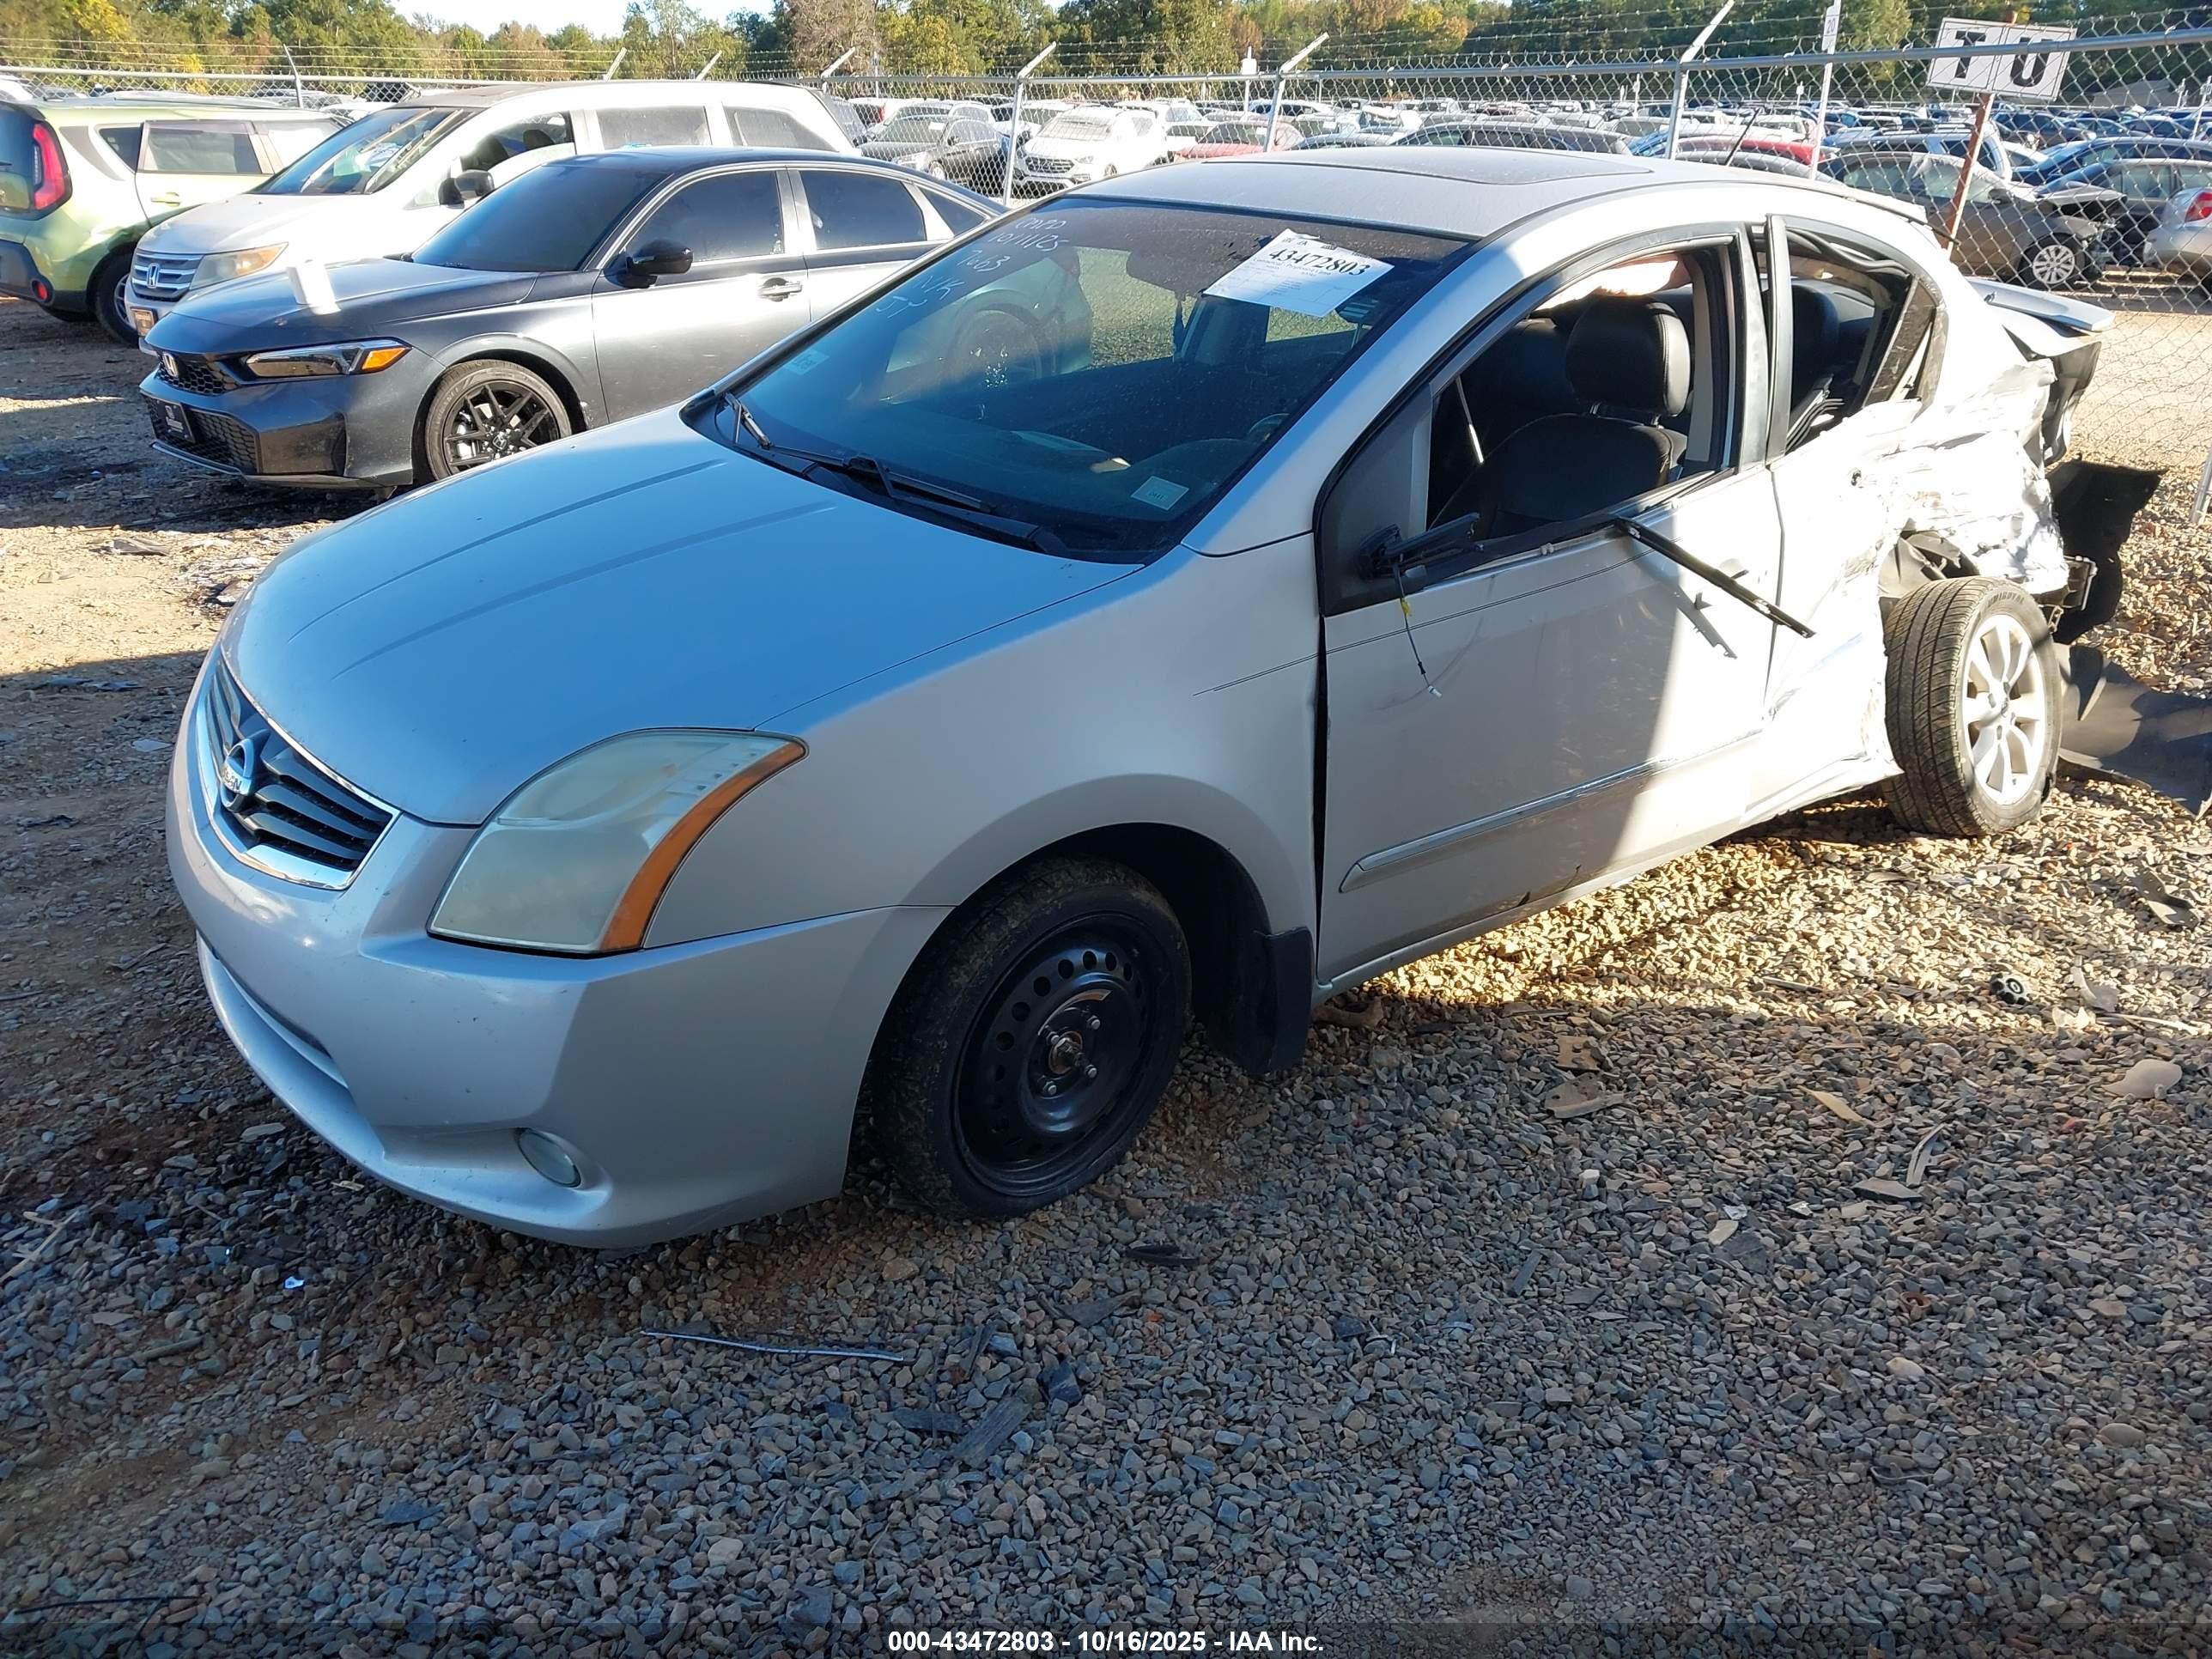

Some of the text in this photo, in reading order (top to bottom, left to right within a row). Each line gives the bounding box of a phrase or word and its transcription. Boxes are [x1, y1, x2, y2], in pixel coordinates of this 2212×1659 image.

[1954, 31, 2053, 87] T U
[988, 233, 1070, 252] 10/11/25
[1269, 248, 1371, 276] 43472803
